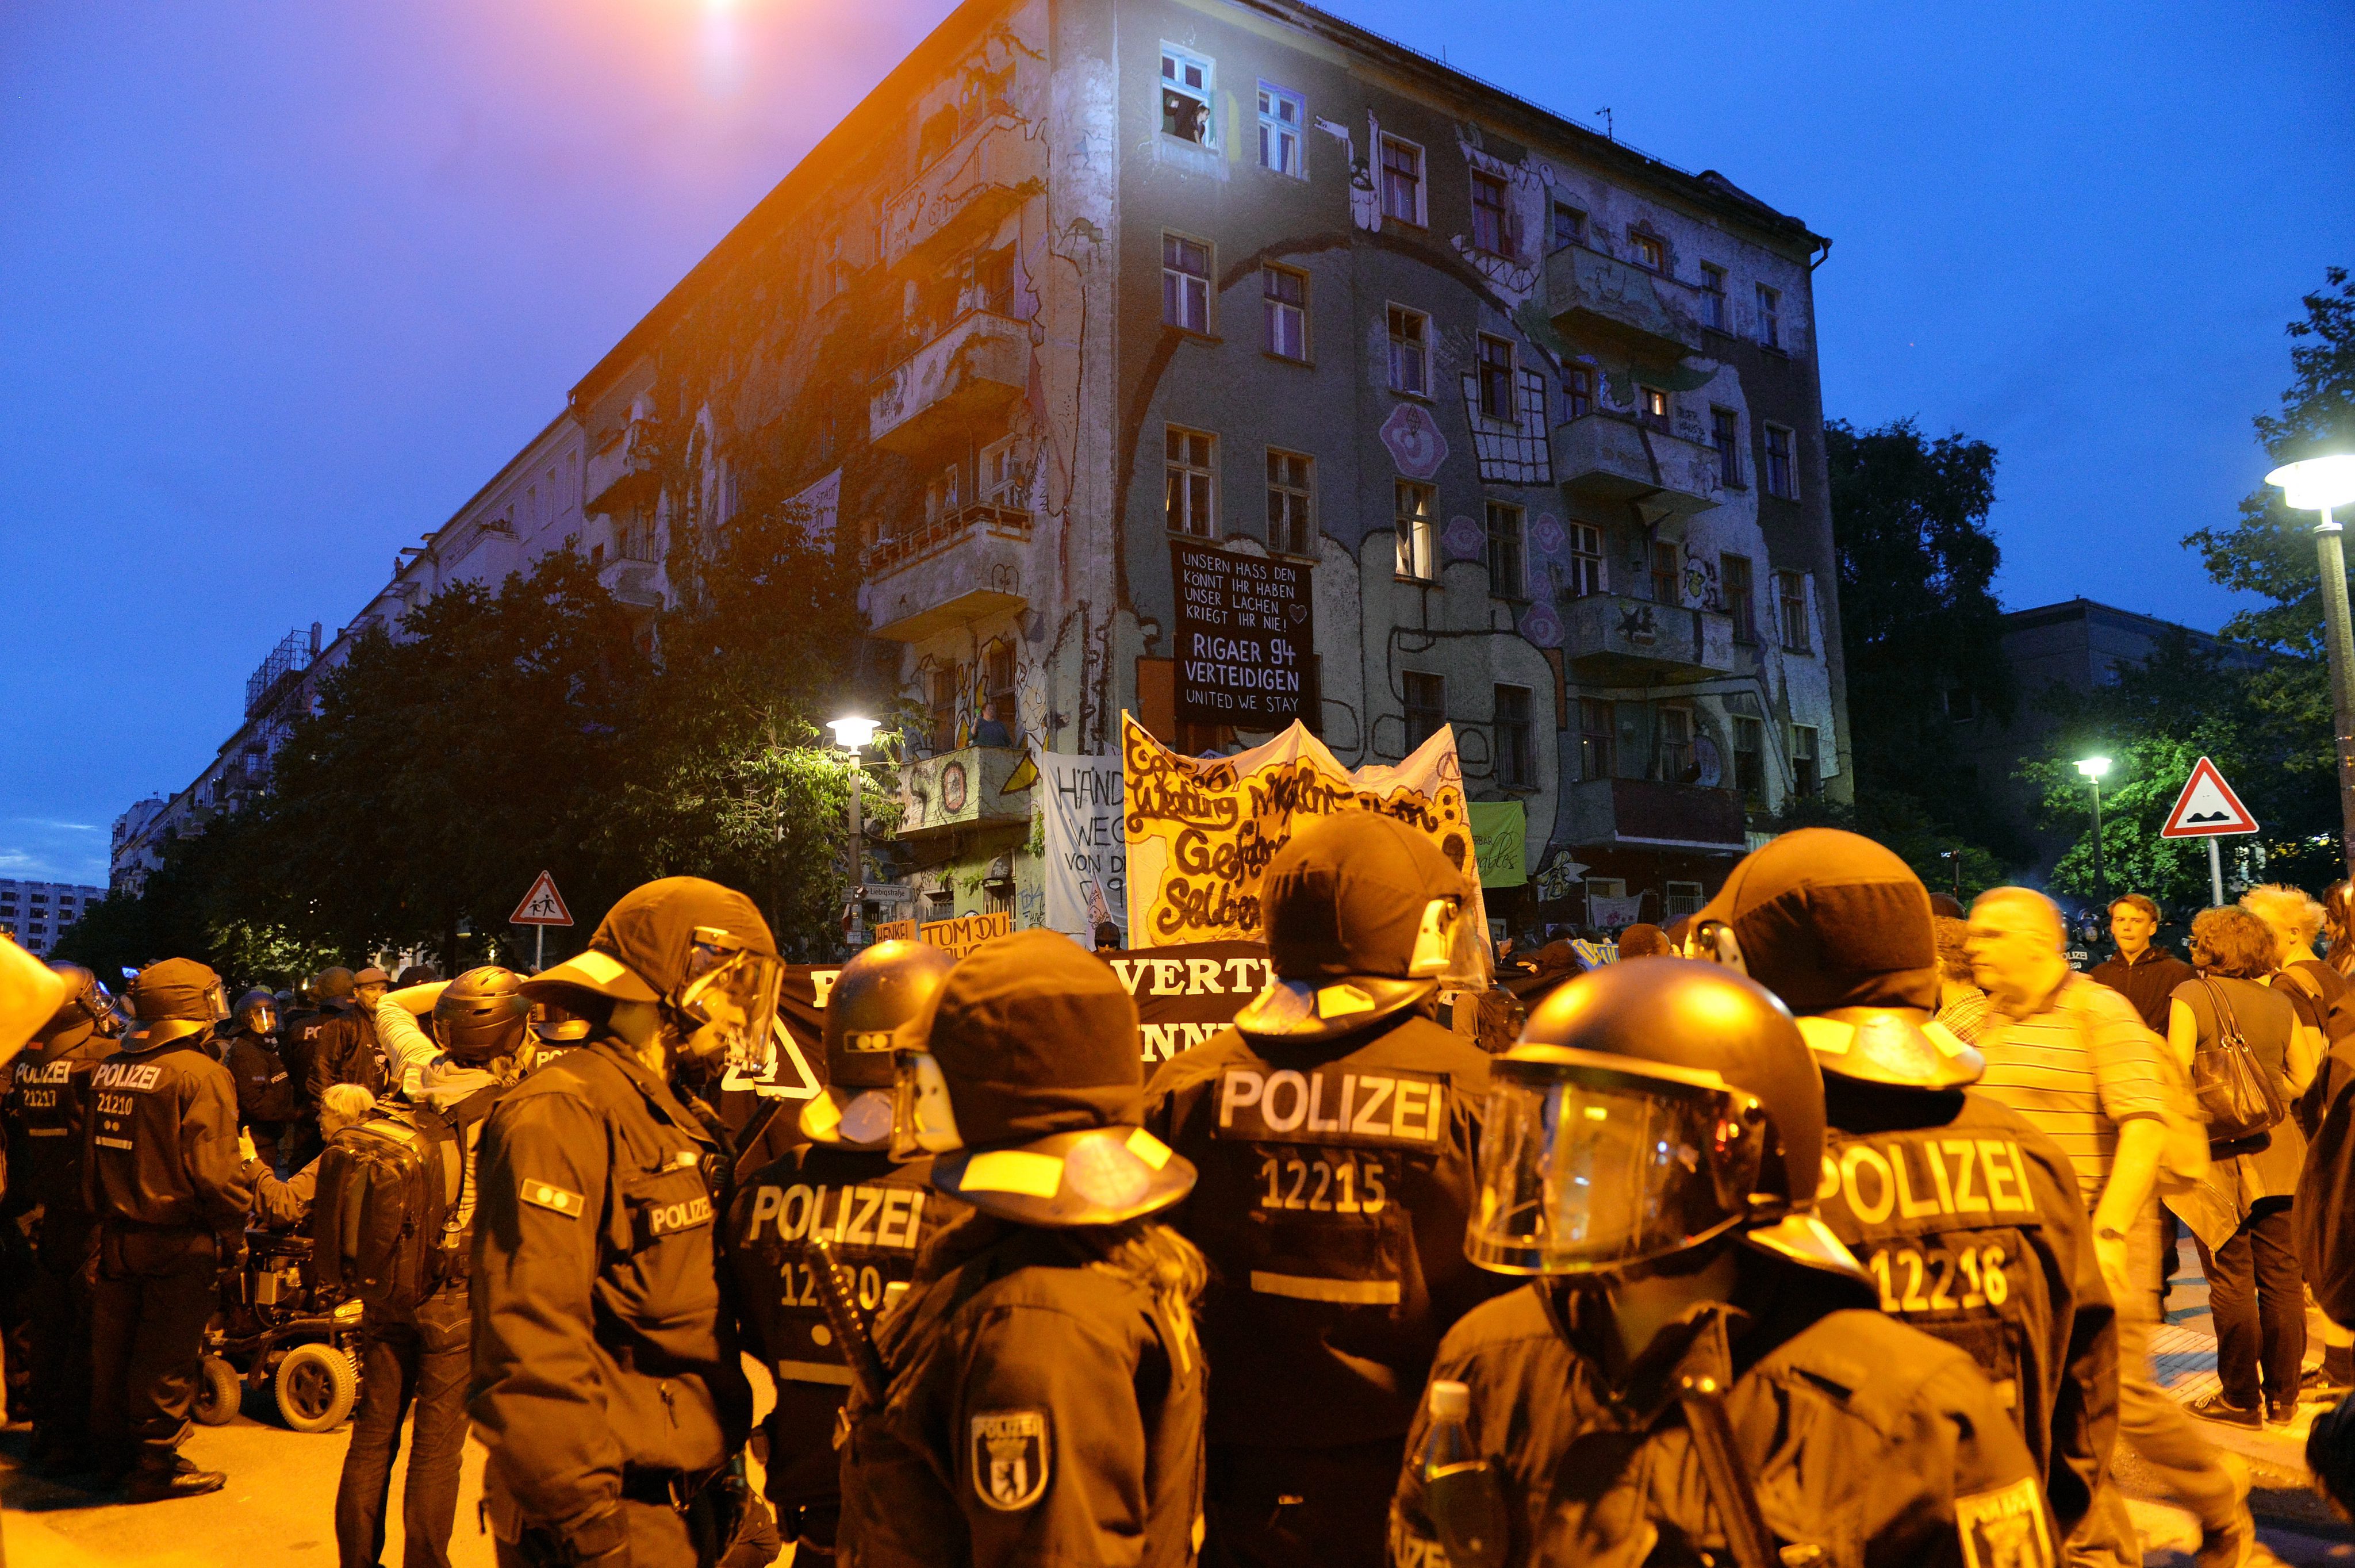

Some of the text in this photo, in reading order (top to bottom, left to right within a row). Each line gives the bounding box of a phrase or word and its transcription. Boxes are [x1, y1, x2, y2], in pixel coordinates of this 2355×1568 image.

[1183, 551, 1295, 582] UNSERN HASS DEN
[1184, 570, 1294, 599] KÖNNT IHR HABEN
[1185, 587, 1279, 615] UNSER LACHEN
[1186, 605, 1228, 624] KRIEGT
[1238, 612, 1256, 627] IHR
[1194, 633, 1296, 665] RIGAER 94
[1185, 660, 1299, 691] VERTEIDIGEN
[1186, 688, 1298, 712] UNITED WE STAY
[1057, 766, 1124, 810] HÄND
[1065, 853, 1101, 873] VON
[870, 887, 905, 898] Liebigstraße
[920, 916, 1006, 946] TOM DU
[2059, 951, 2088, 960] OLIZEI
[16, 1061, 74, 1084] POLIZEI
[91, 1064, 162, 1090] POLIZEI
[24, 1089, 56, 1107] 21217
[97, 1092, 133, 1115] 21210
[1219, 1069, 1442, 1141] POLIZEI
[1261, 1159, 1386, 1213] 12215
[651, 1196, 713, 1233] POLIZE
[749, 1183, 925, 1249] POLIZEI
[780, 1261, 881, 1310] 120
[1869, 1244, 2008, 1313] 12216
